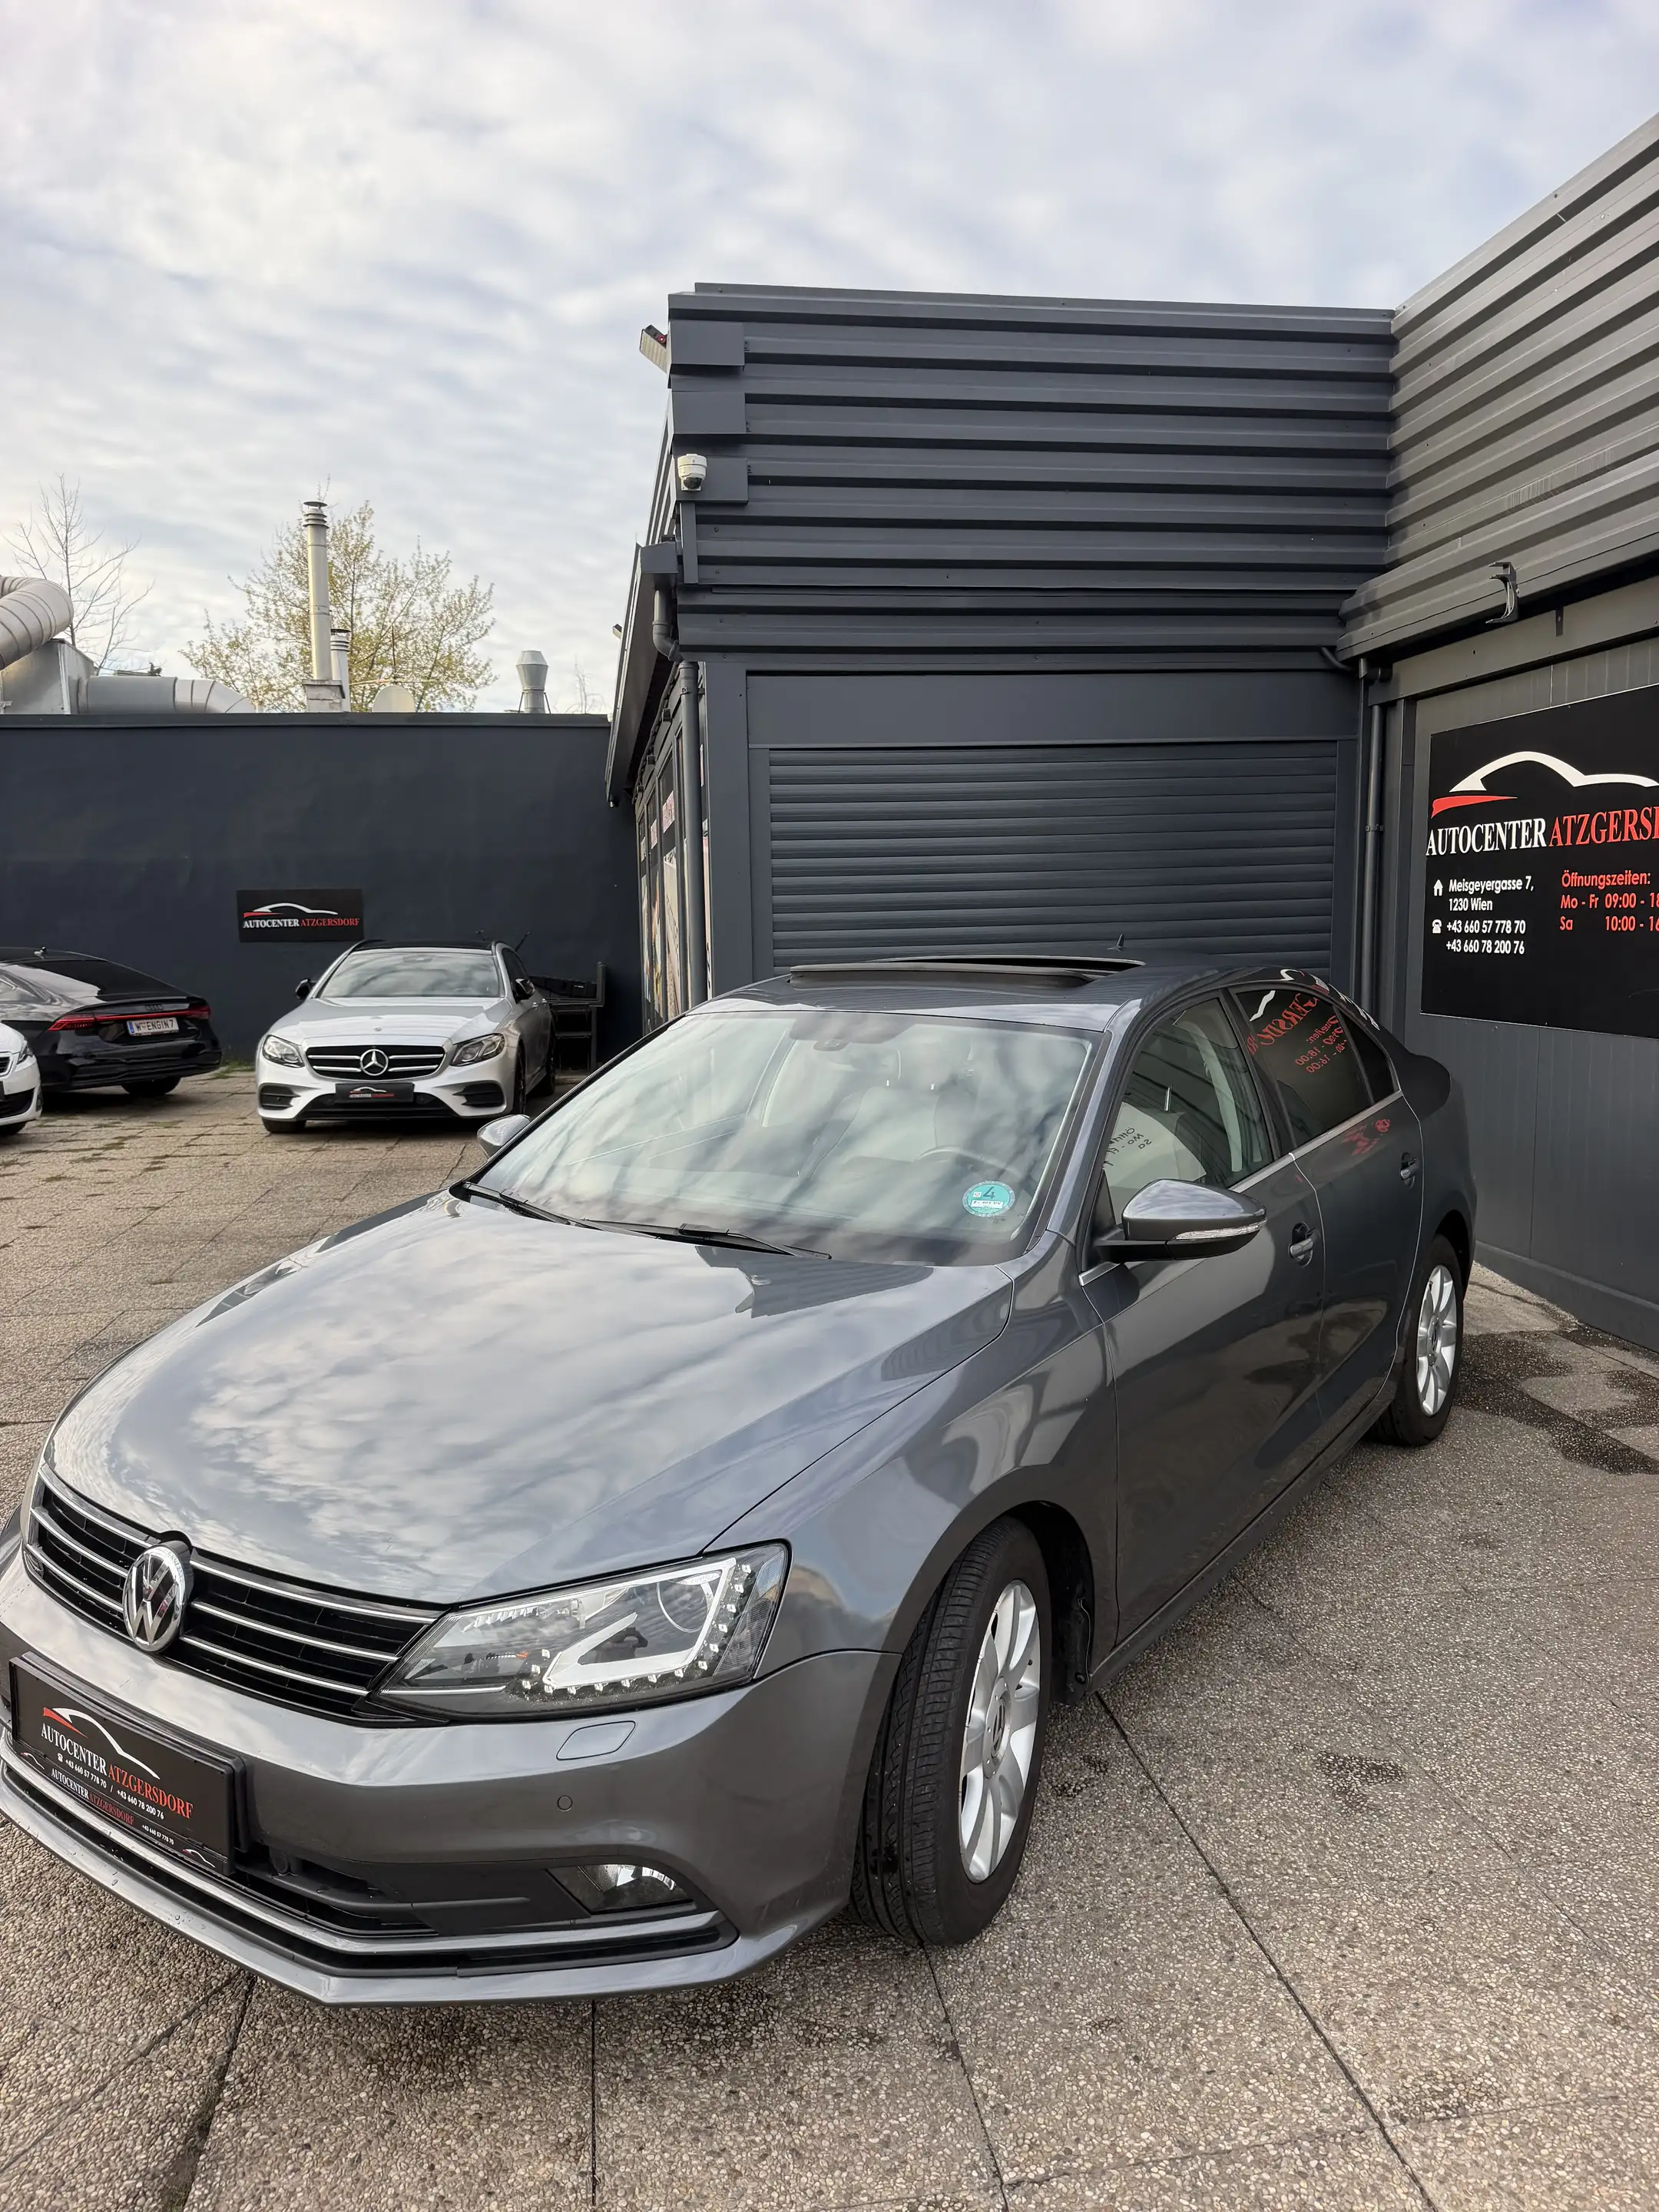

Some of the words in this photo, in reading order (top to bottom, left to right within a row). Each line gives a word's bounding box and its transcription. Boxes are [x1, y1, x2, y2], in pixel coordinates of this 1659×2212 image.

[1426, 817, 1547, 856] AUTOCENTER
[1449, 878, 1523, 895] Meisgeyergasse
[1525, 875, 1534, 892] 7,
[1561, 869, 1651, 890] Öffnungszeiten:
[1449, 897, 1469, 912] 1230
[1470, 897, 1493, 911] Wien
[1560, 894, 1578, 909] Mo
[1589, 893, 1599, 909] Fr
[1604, 892, 1637, 909] 09:00
[243, 919, 300, 929] AUTOCENTER
[300, 917, 360, 927] ATZGERSDORF
[1446, 919, 1462, 933] +43
[1464, 919, 1480, 934] 660
[1482, 919, 1493, 934] 57
[1495, 919, 1512, 934] 778
[1514, 919, 1526, 935] 70
[1559, 916, 1573, 931] Sa
[1605, 916, 1636, 932] 10:00
[1445, 939, 1462, 952] +43
[1463, 939, 1479, 953] 660
[1481, 939, 1492, 954] 78
[1494, 939, 1512, 954] 200
[1513, 940, 1525, 955] 76
[983, 1186, 995, 1199] 4
[41, 1723, 108, 1777] AUTOCENTER
[108, 1763, 194, 1820] ATZGERSDORF
[51, 1768, 90, 1800] AUTOCENTER
[89, 1792, 134, 1826] ATZGERSDORF
[75, 1764, 84, 1776] 660
[84, 1769, 90, 1779] 57
[91, 1773, 100, 1784] 778
[101, 1778, 107, 1789] 70
[127, 1794, 137, 1806] 660
[138, 1800, 145, 1810] 78
[146, 1804, 157, 1816] 200
[157, 1810, 164, 1820] 76
